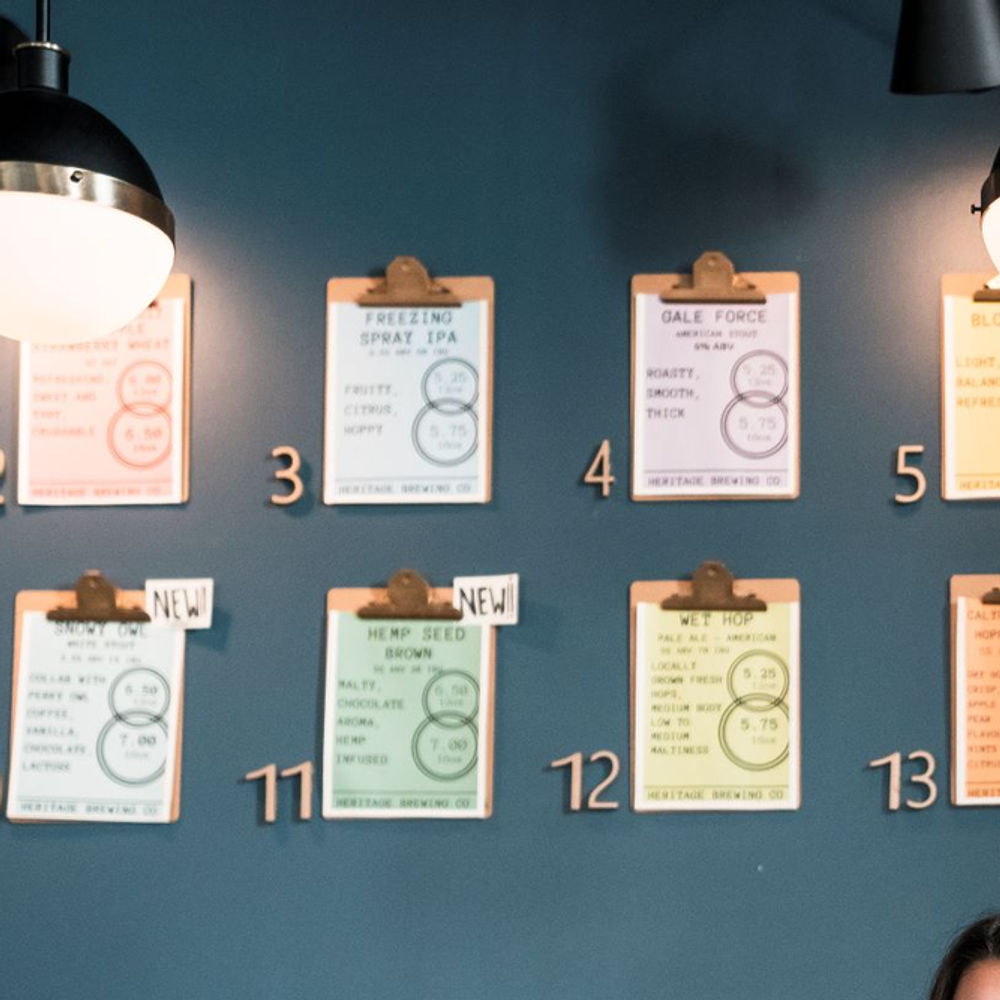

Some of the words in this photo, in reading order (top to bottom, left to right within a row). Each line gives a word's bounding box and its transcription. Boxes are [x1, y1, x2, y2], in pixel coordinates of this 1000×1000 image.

[364, 311, 454, 326] FREEZING
[714, 308, 769, 325] FORCE
[359, 330, 413, 347] SPRAY
[426, 330, 459, 345] IPA
[645, 407, 686, 420] THICK
[343, 423, 384, 437] HOPPY
[270, 444, 304, 505] 3
[584, 439, 617, 497] 4
[894, 443, 928, 503] 5
[647, 475, 704, 488] HERITAGE
[710, 475, 760, 488] BREWING
[338, 483, 394, 495] HERITAGE
[400, 483, 450, 495] BREWING
[152, 586, 208, 621] NEW!
[679, 613, 711, 627] WET
[721, 612, 755, 626] HOP
[367, 626, 411, 641] HEMP
[422, 626, 467, 642] SEED
[385, 646, 433, 660] BROWN
[743, 667, 778, 680] 5.25
[336, 699, 405, 711] CHOCOLATE
[650, 703, 691, 713] MEDIUM
[650, 718, 673, 728] LOW
[678, 718, 691, 728] TO
[740, 717, 779, 732] 5.75
[335, 735, 367, 746] HEMP
[650, 732, 691, 741] MEDIUM
[650, 745, 710, 756] MALTINESS
[335, 754, 389, 766] INFUSED
[550, 748, 620, 812] 12
[869, 749, 939, 811] 13
[245, 760, 315, 823] 11
[647, 789, 705, 801] HERITAGE
[711, 789, 764, 801] BREWING
[334, 797, 394, 809] HERITAGE
[398, 797, 450, 809] BREWING
